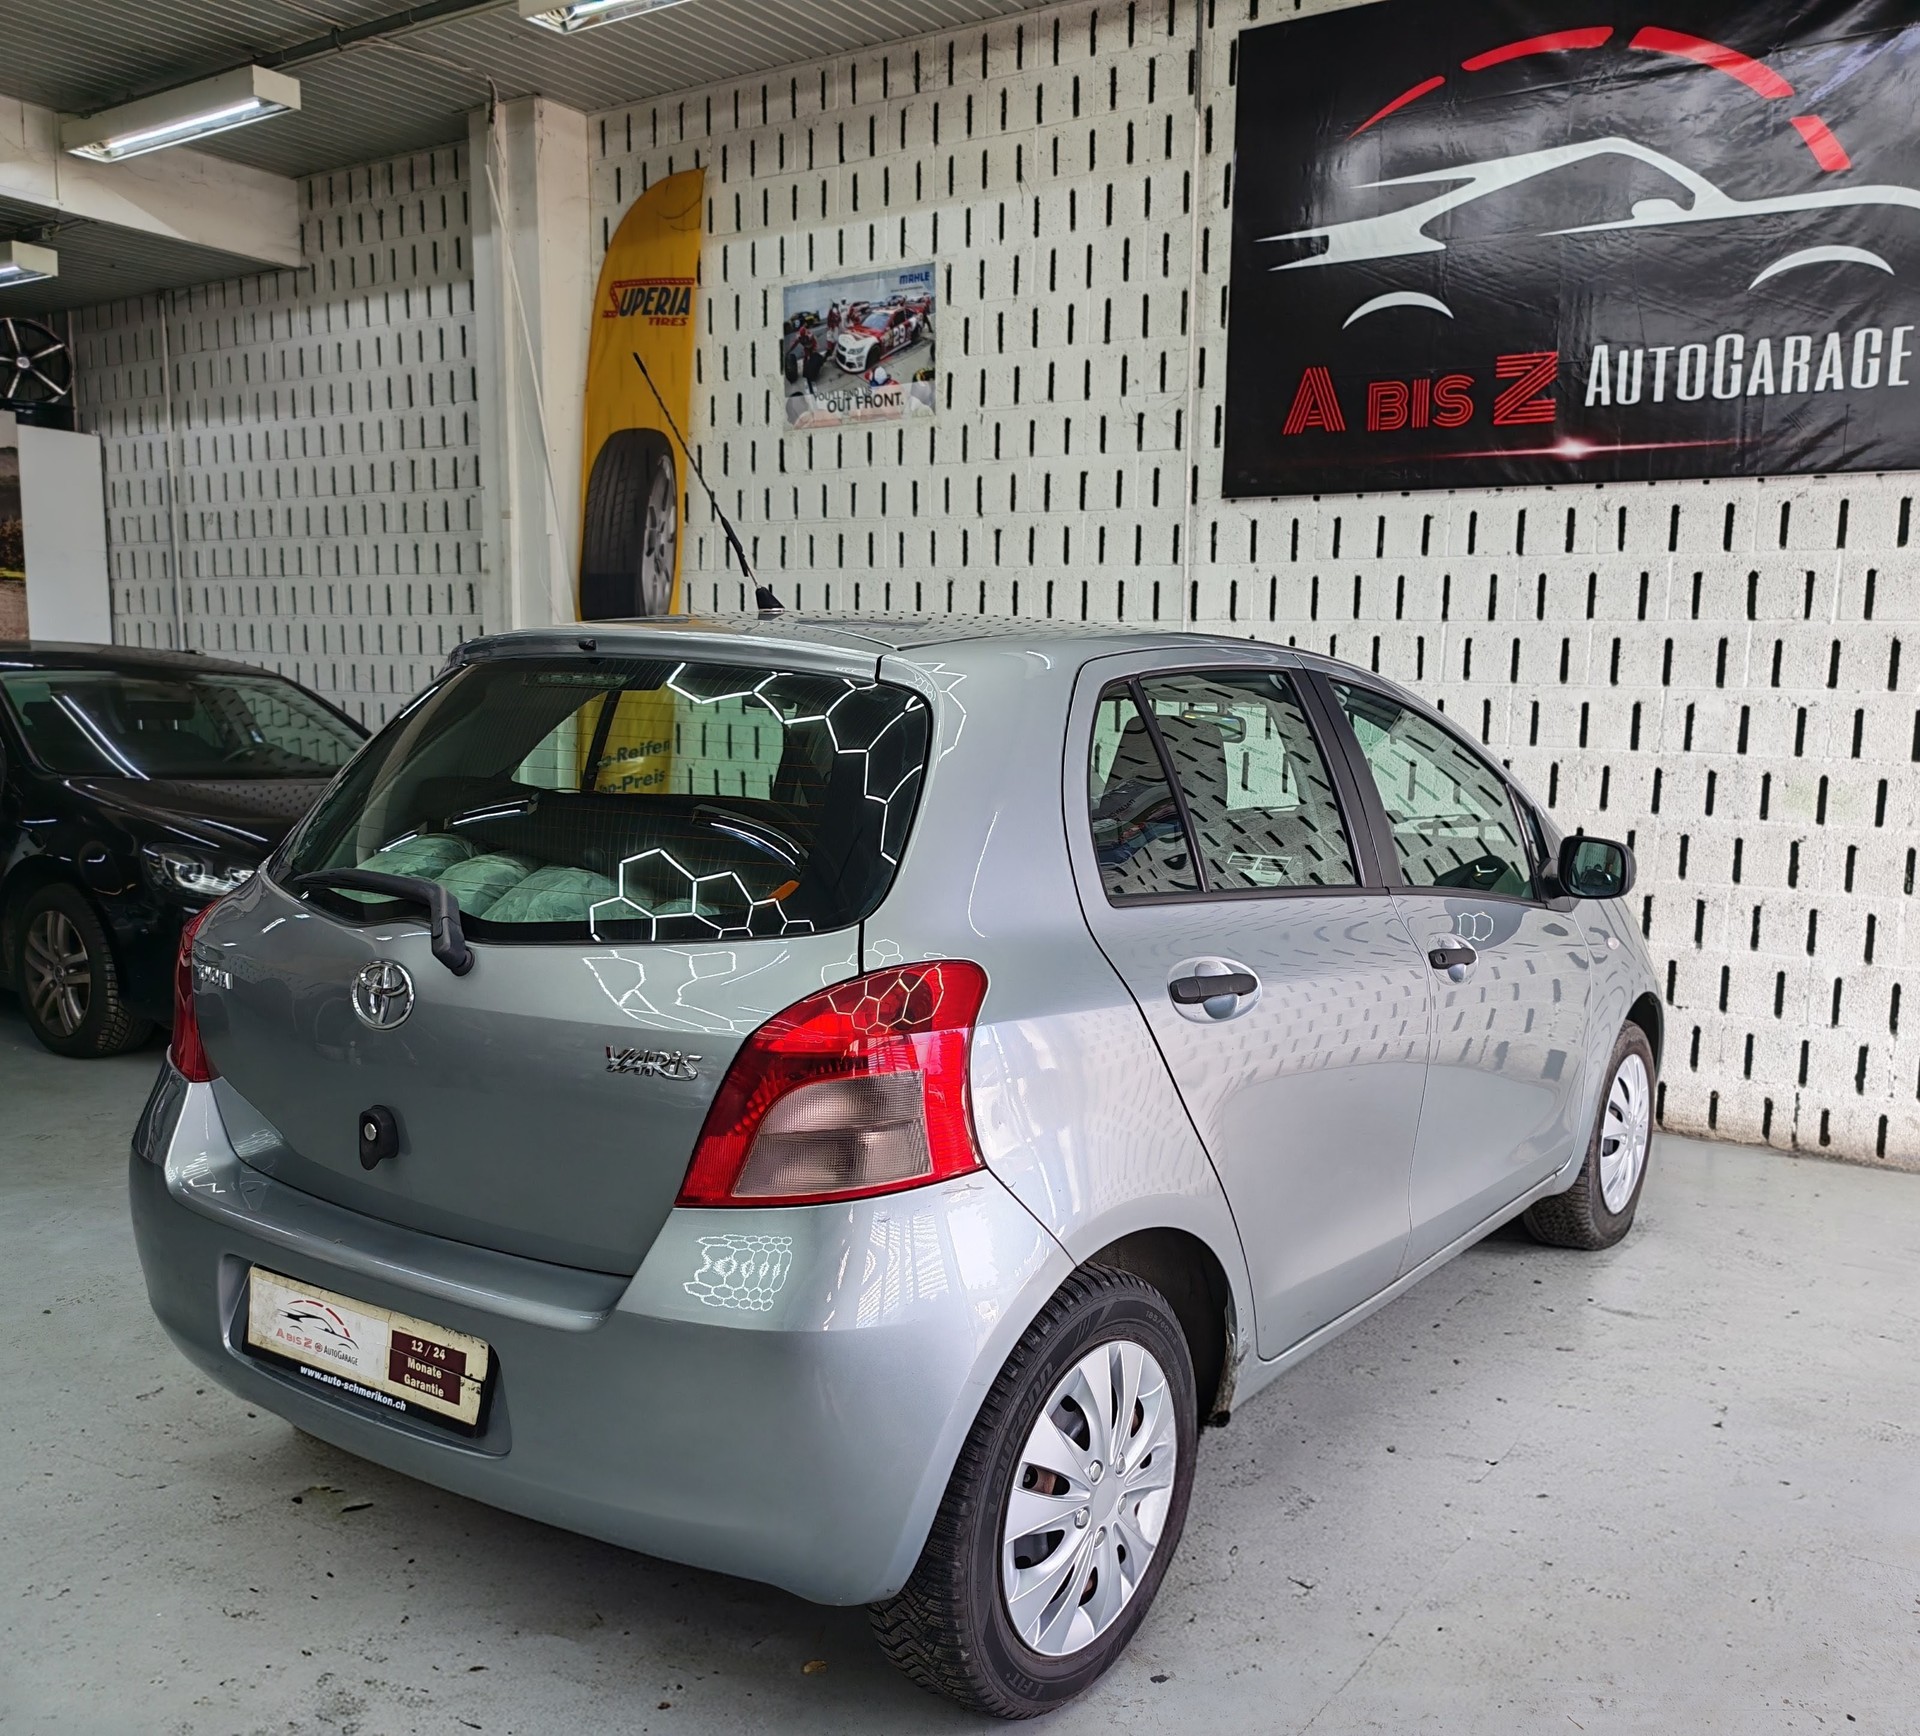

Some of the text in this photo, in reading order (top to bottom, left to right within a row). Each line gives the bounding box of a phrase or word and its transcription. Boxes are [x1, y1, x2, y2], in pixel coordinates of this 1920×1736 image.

[899, 271, 931, 285] MAHLE
[603, 278, 695, 318] SUPERIA
[648, 317, 689, 327] TIRES
[827, 391, 904, 413] OUT FRONT.
[1282, 366, 1346, 435] A
[1493, 351, 1558, 426] Z
[276, 1327, 285, 1339] A
[304, 1336, 313, 1349] Z
[411, 1340, 446, 1360] 12 / 24
[407, 1356, 443, 1379] Monate
[300, 1365, 407, 1412] www.auto-schmerikon.ch
[403, 1373, 445, 1398] Garantie
